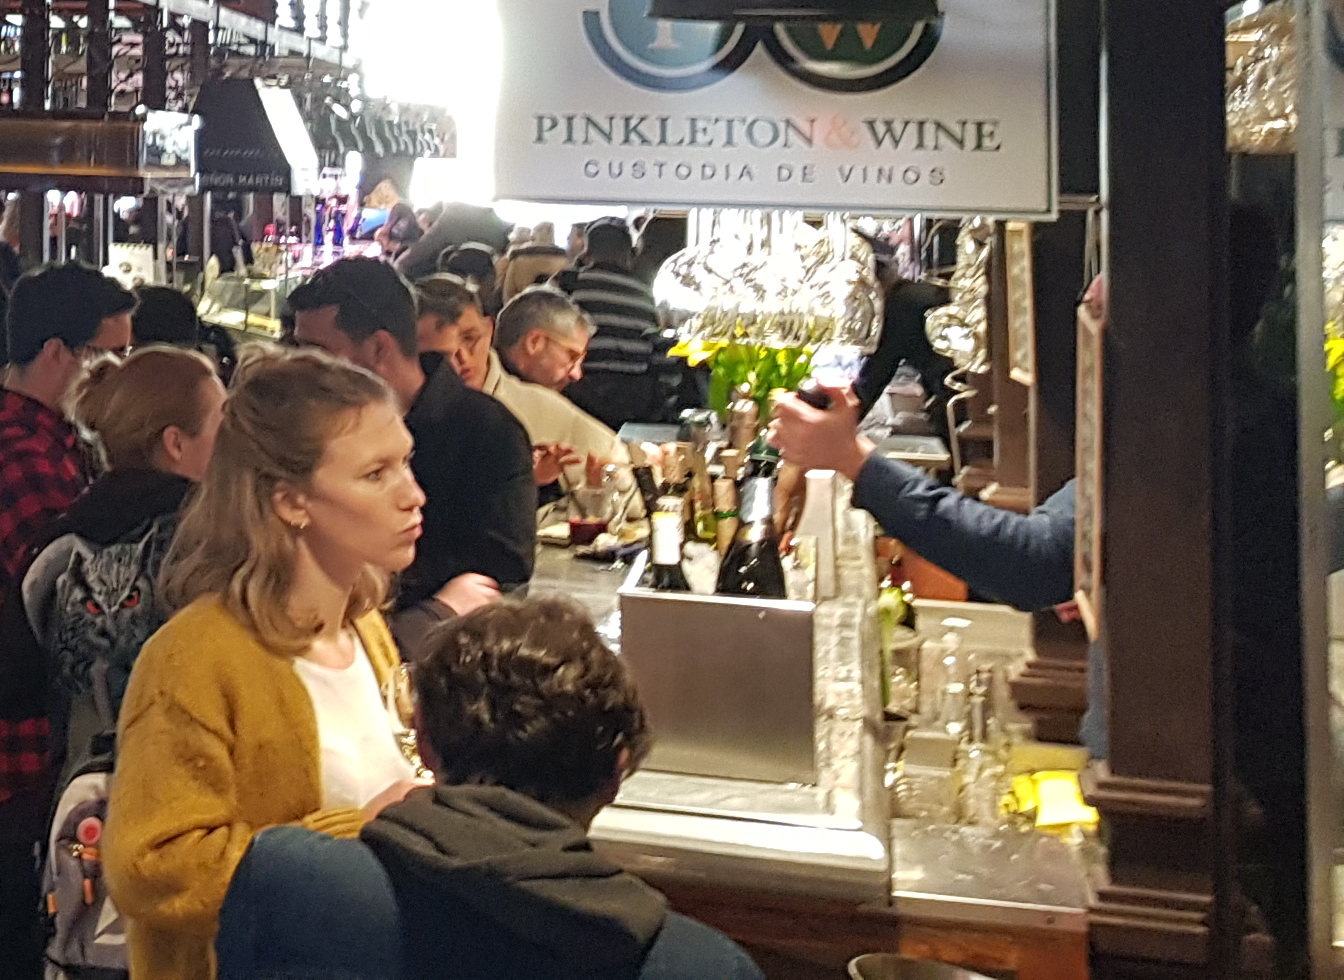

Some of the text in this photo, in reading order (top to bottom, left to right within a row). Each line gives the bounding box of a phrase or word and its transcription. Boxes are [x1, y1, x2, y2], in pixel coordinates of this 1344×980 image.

[583, 159, 946, 186] CUSTODIA DE VINOS
